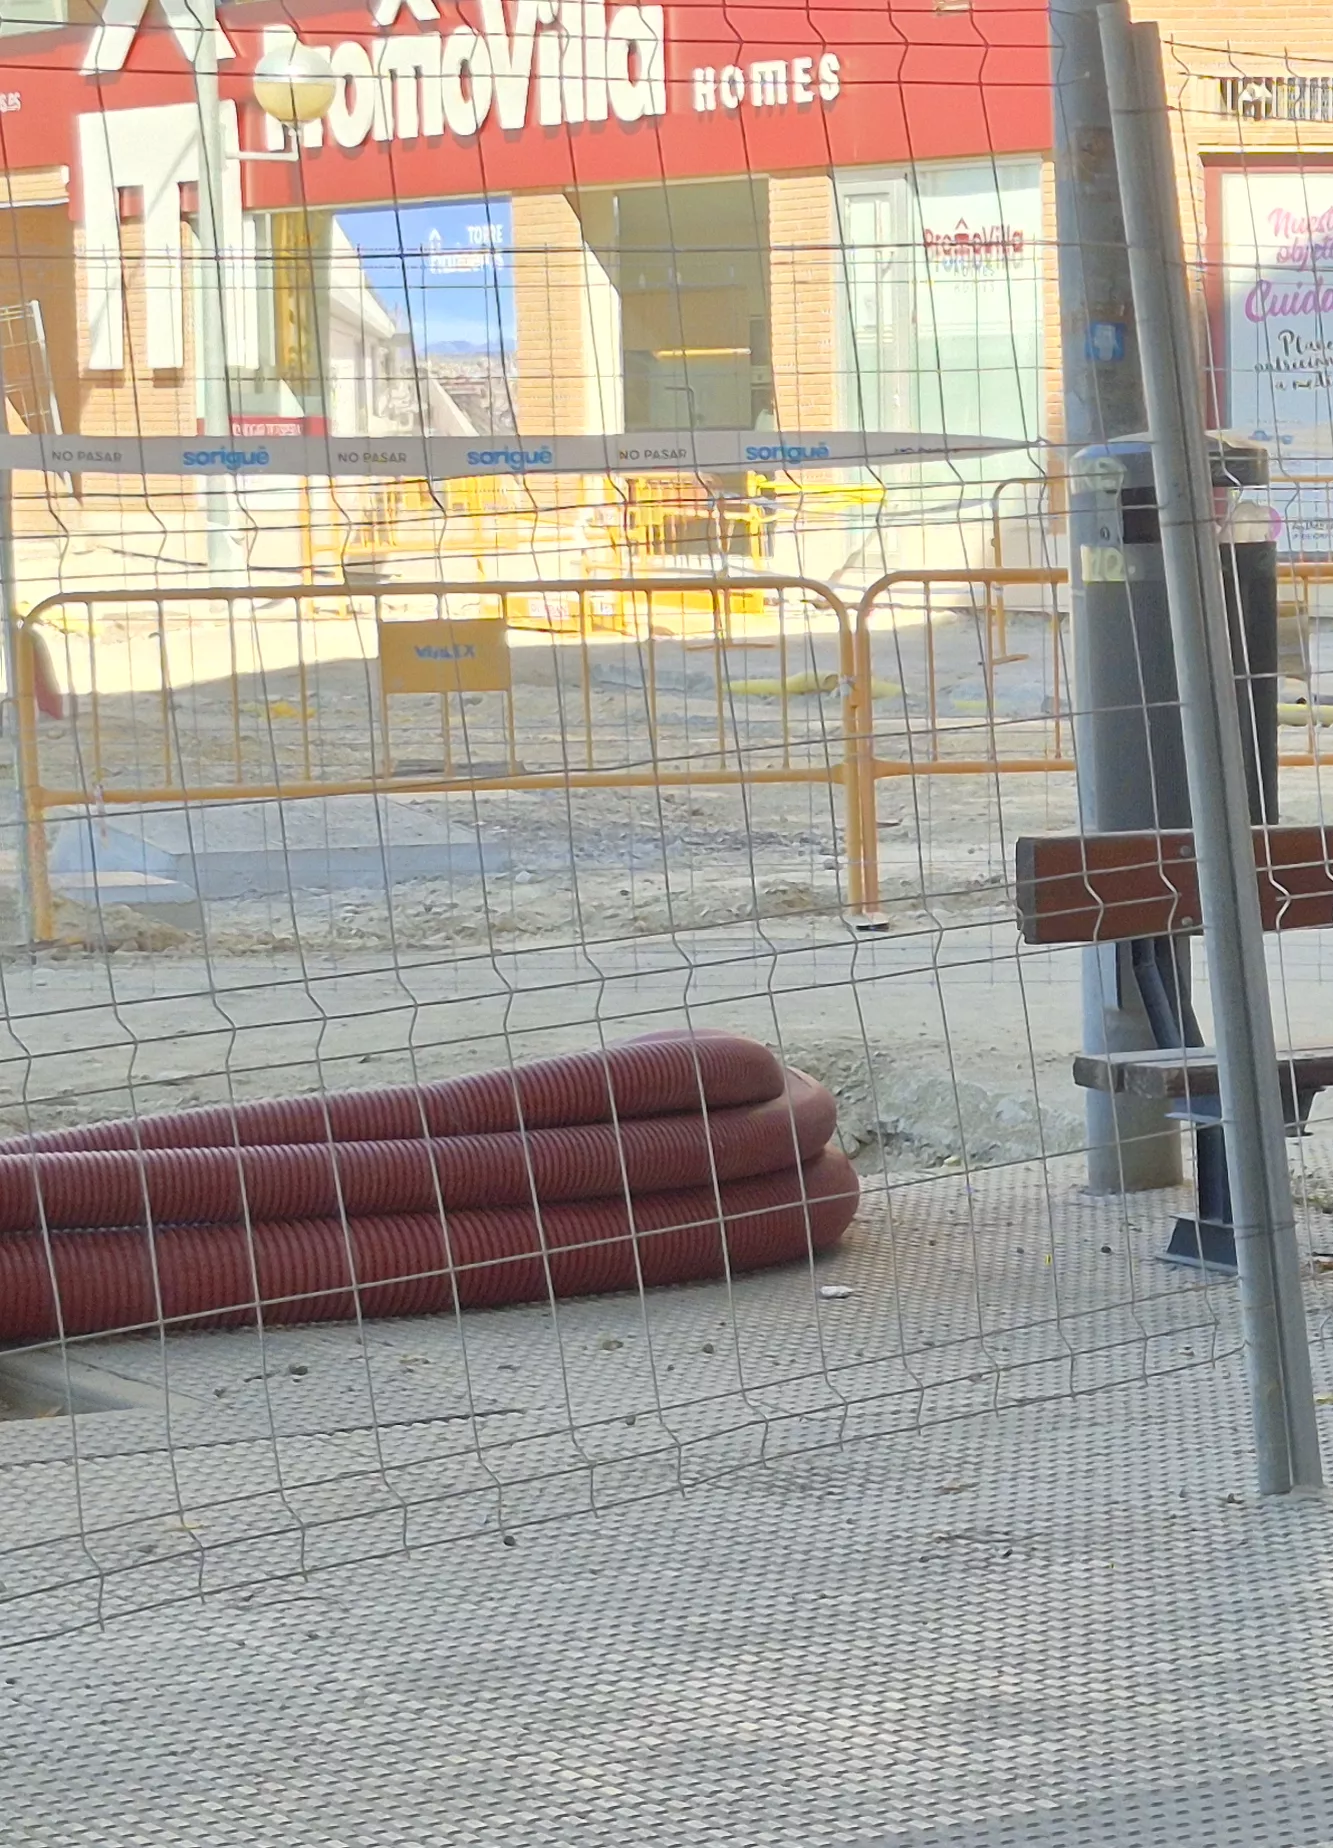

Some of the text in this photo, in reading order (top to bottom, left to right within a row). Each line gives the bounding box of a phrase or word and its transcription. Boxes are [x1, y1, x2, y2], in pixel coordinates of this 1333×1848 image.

[692, 52, 841, 113] HOMES
[51, 450, 123, 462] NO PASAR
[338, 452, 408, 463] NO PASAR
[619, 449, 687, 460] NO PASAR
